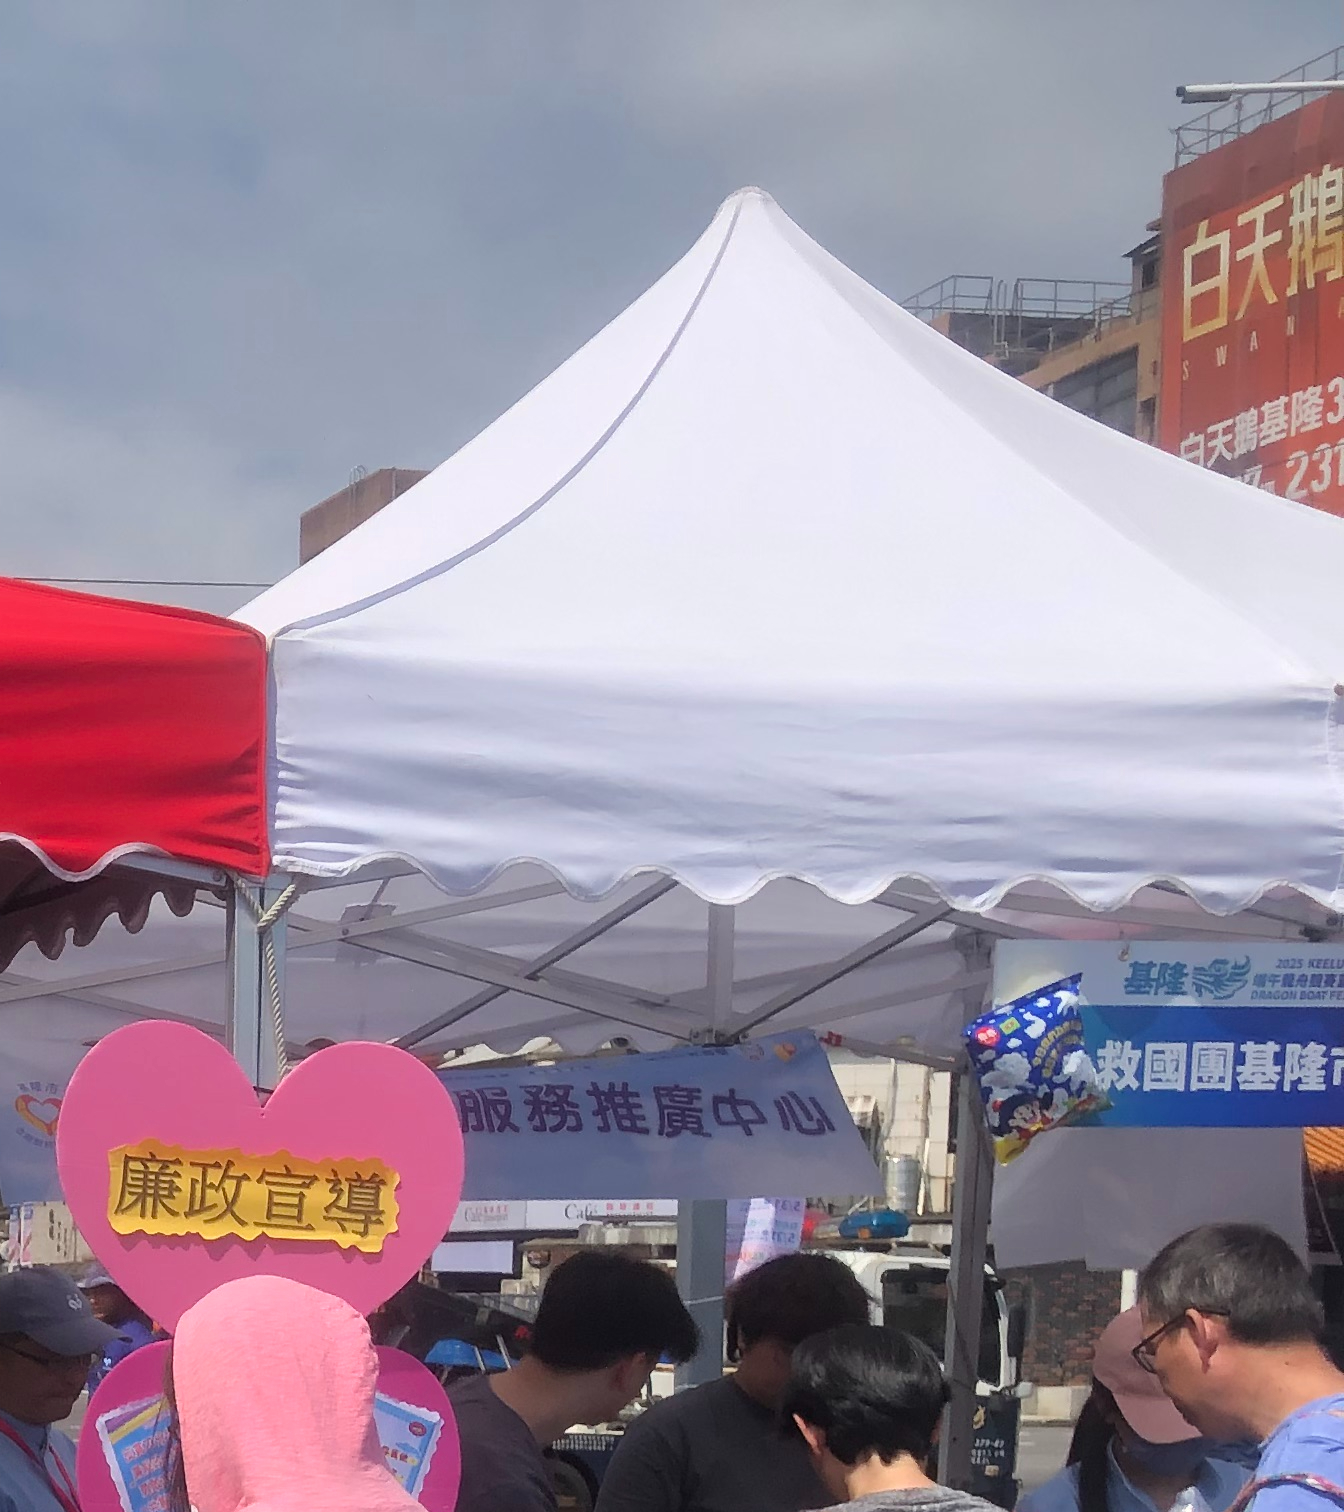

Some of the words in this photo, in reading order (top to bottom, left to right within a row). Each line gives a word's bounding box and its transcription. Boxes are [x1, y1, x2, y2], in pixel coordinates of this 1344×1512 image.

[1183, 163, 1344, 342] 白天鵝
[1124, 960, 1189, 996] 基隆
[1275, 958, 1303, 969] 2025
[1250, 990, 1297, 1001] DRAGON
[1299, 990, 1327, 1001] BOAT
[112, 1151, 388, 1238] 廉政宣導
